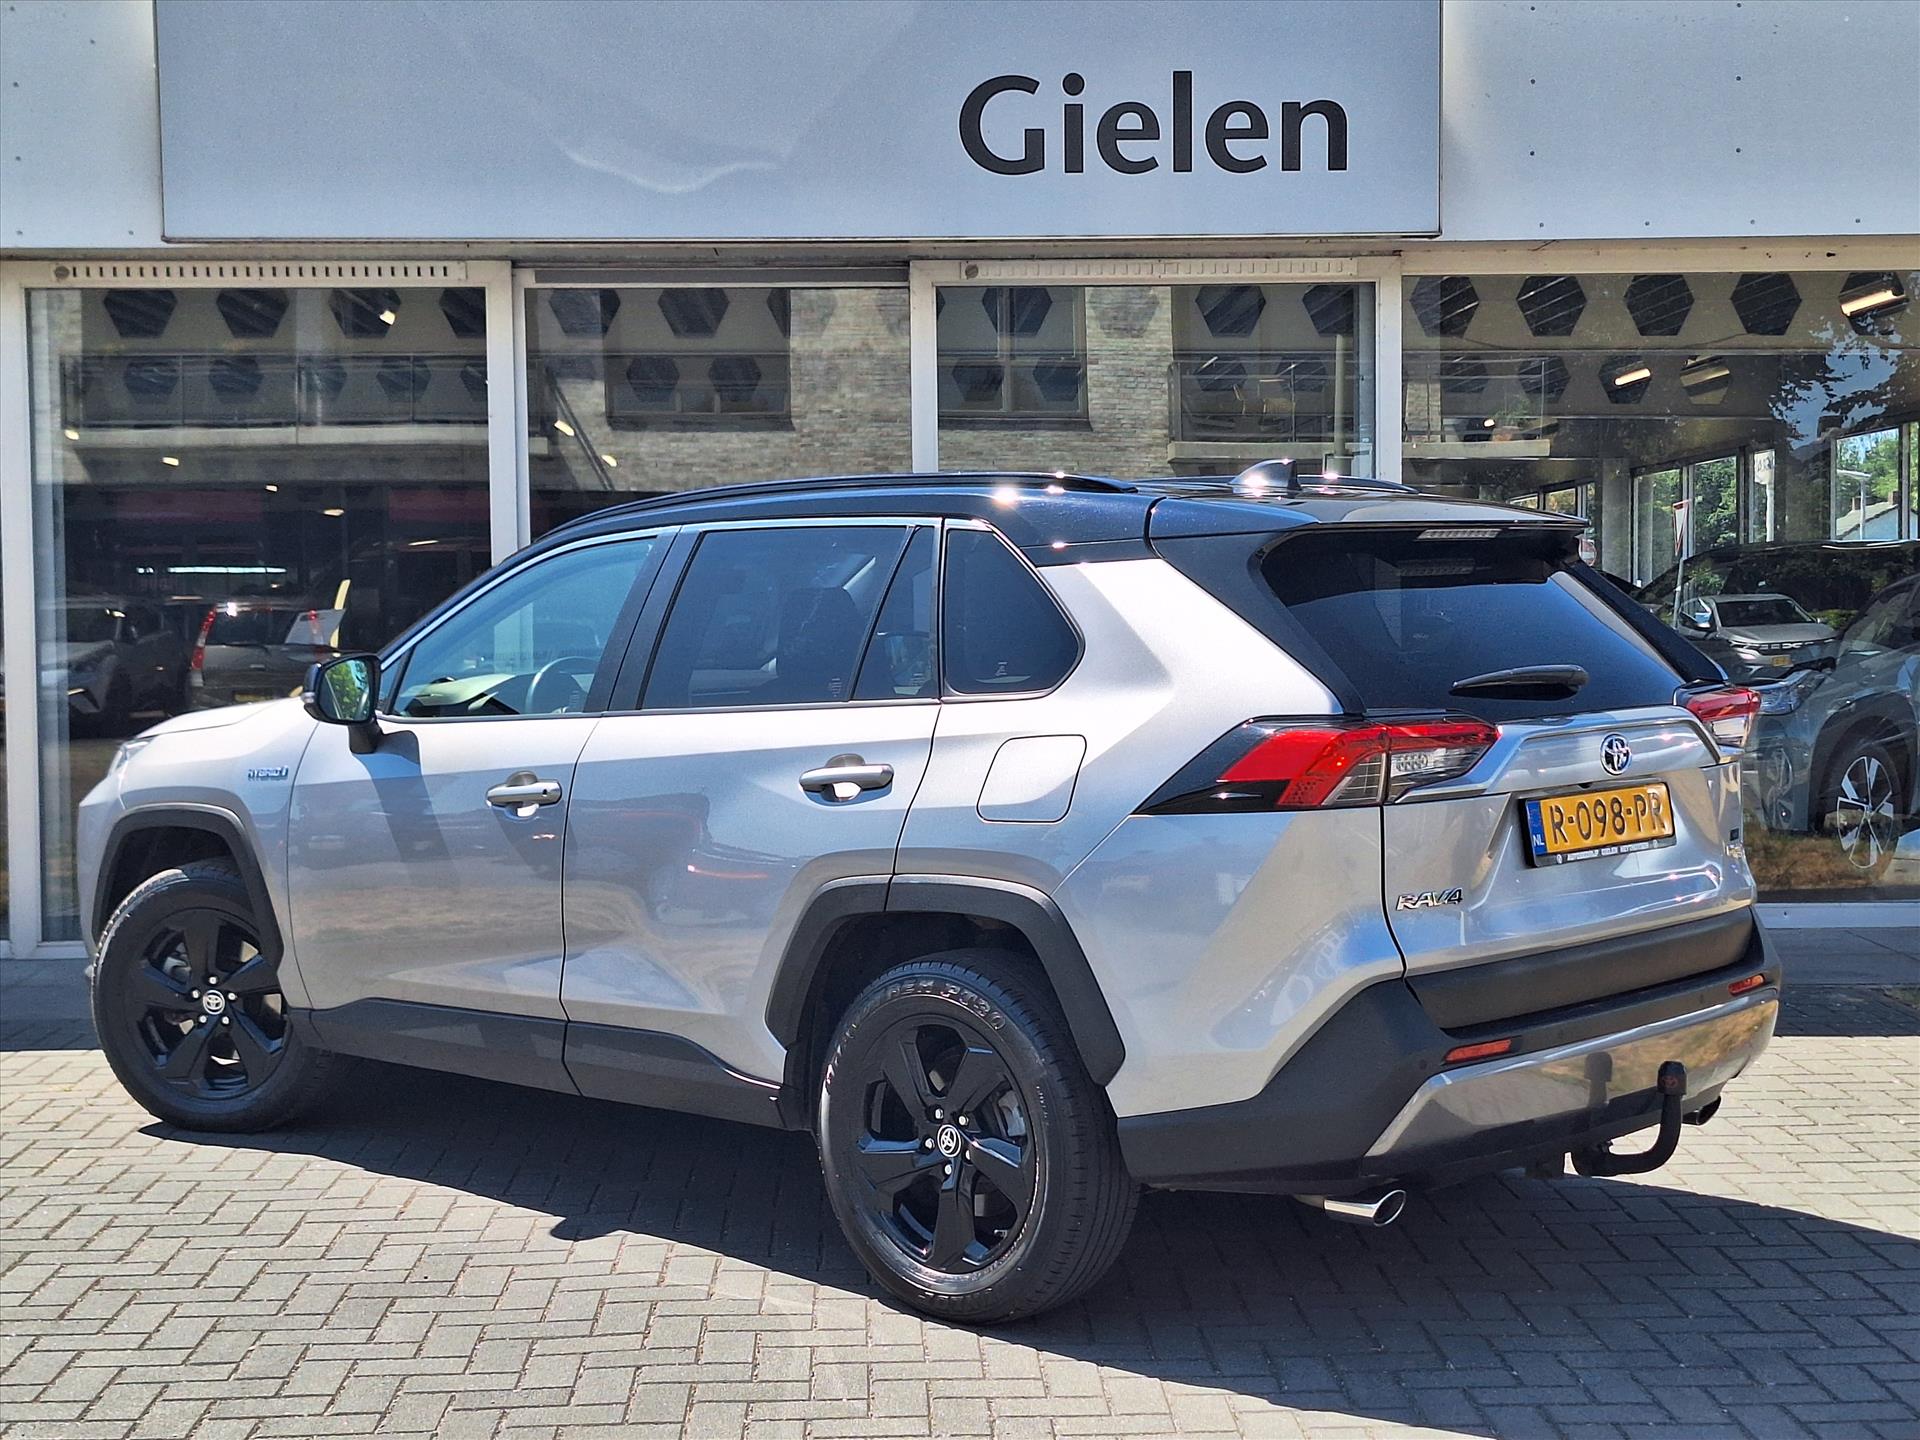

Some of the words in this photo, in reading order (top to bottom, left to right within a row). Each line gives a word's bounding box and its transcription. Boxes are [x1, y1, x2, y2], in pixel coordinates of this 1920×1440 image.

[958, 70, 1348, 176] Gielen
[1549, 792, 1667, 845] R-098-PR
[1532, 834, 1545, 846] NL
[1396, 887, 1463, 911] RAV4
